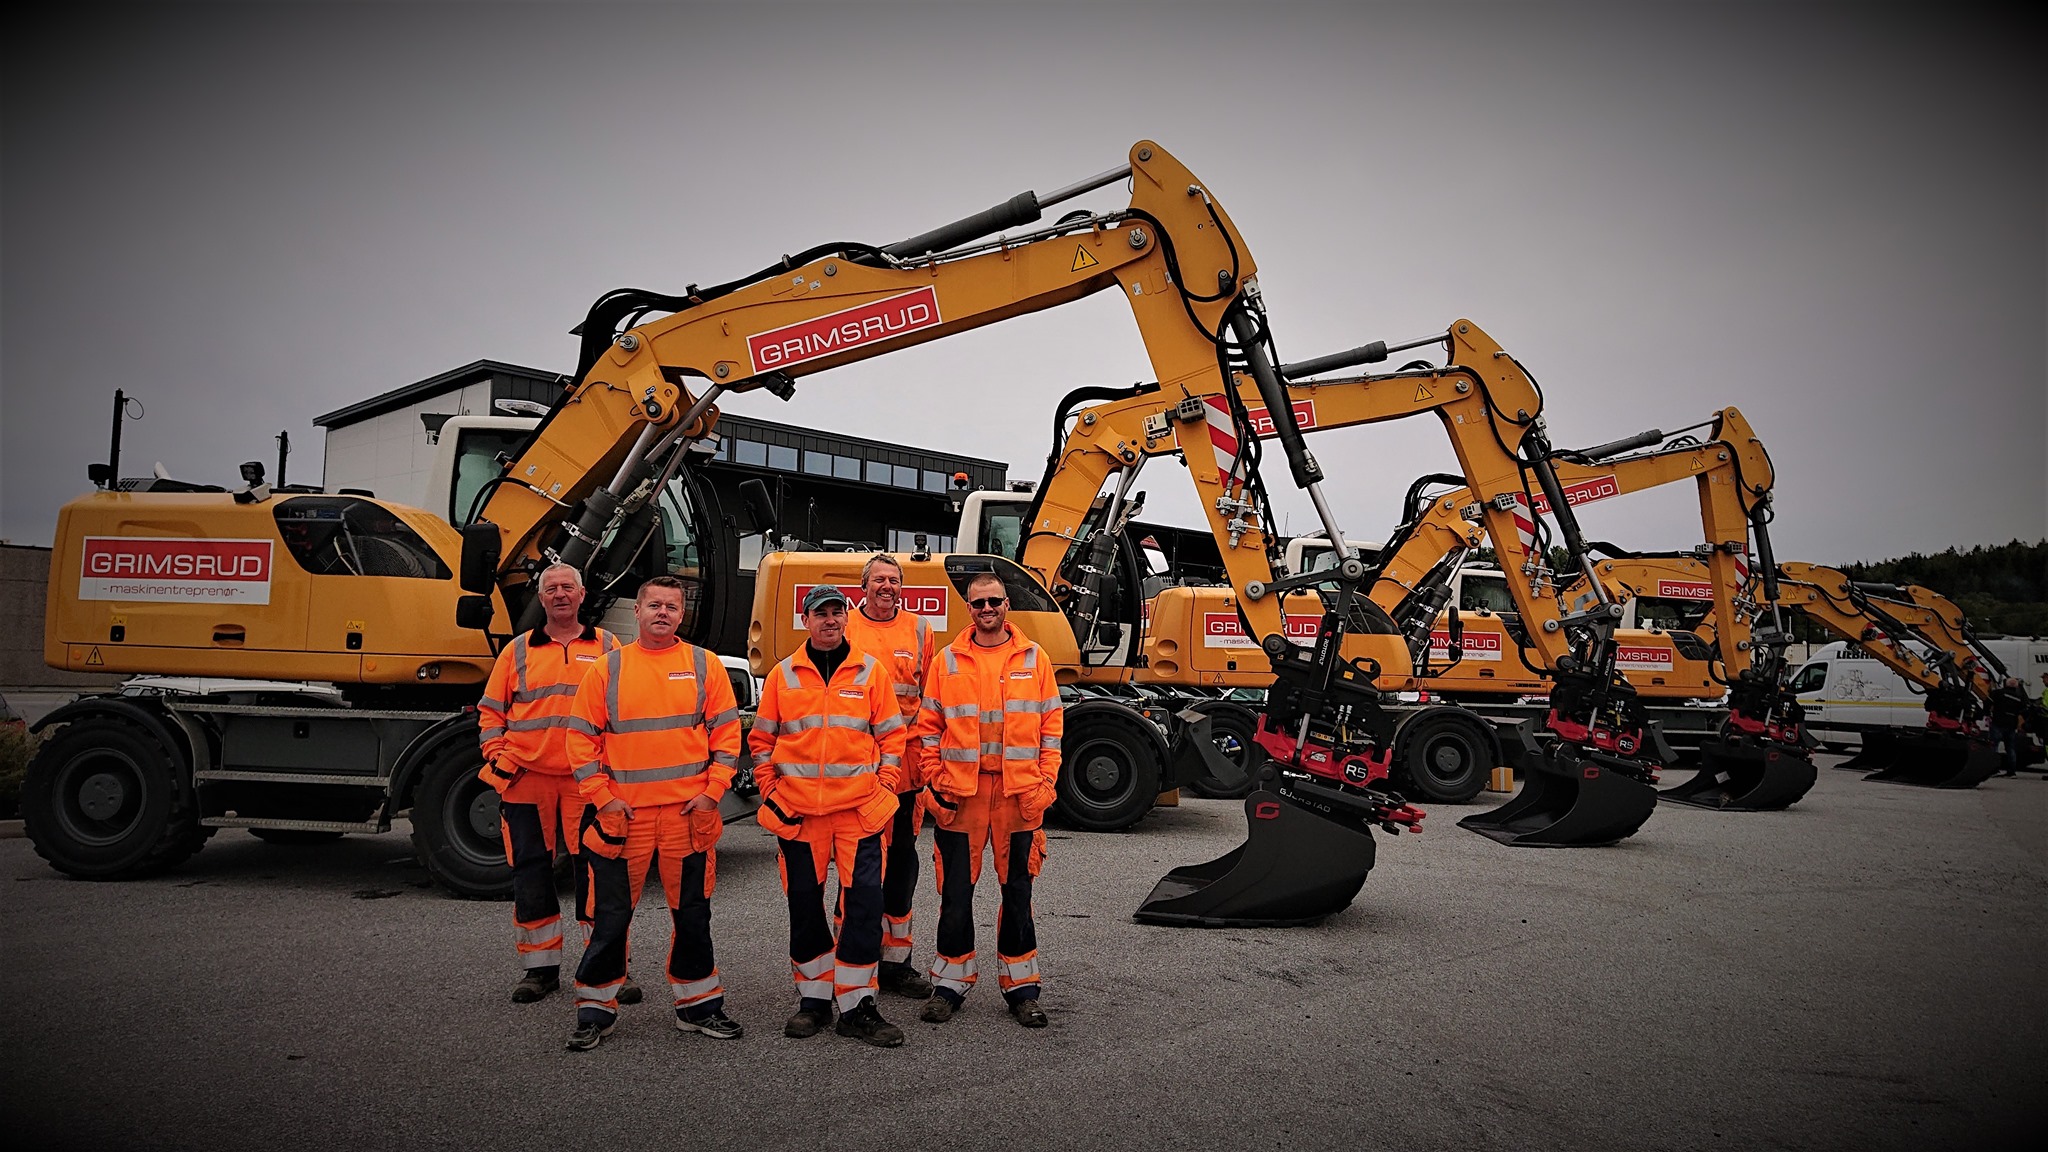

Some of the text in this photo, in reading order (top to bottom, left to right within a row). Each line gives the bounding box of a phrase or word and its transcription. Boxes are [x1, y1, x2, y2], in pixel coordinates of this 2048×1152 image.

[760, 303, 930, 365] GRIMSRUD
[91, 552, 262, 577] GRIMSRUD
[1619, 740, 1634, 750] R5
[1345, 764, 1367, 779] R5
